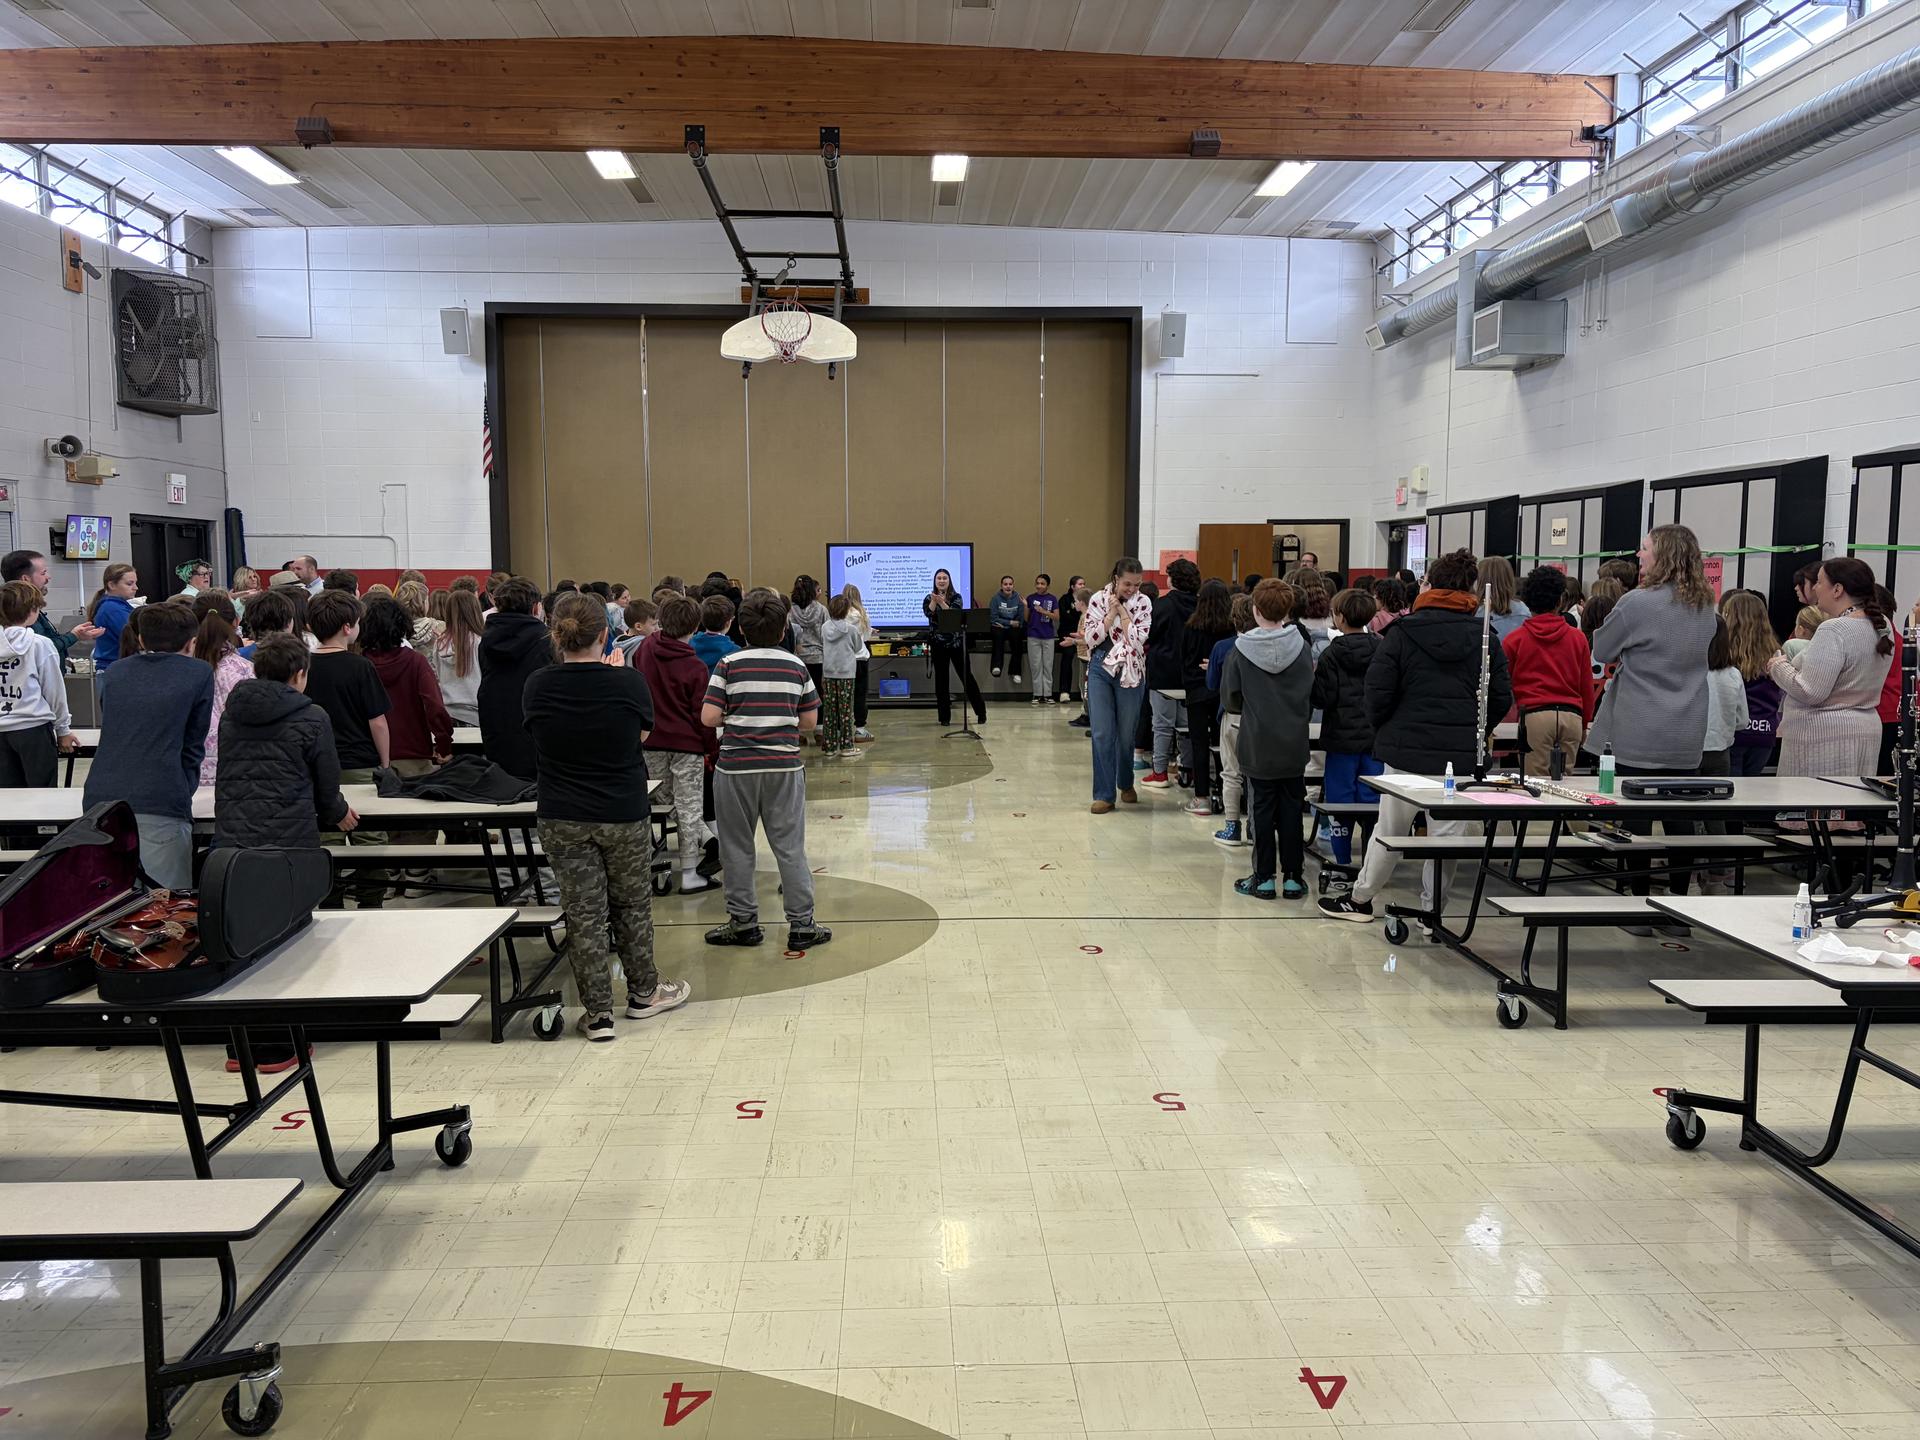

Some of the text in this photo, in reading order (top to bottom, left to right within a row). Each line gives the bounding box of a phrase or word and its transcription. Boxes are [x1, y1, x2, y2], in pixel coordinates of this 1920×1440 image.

[173, 486, 184, 502] EXIT
[1552, 528, 1566, 537] Staff
[845, 551, 872, 568] Choir
[0, 658, 20, 670] EP
[0, 685, 22, 700] LLO
[1298, 1367, 1348, 1410] 4
[662, 1382, 713, 1427] 4
